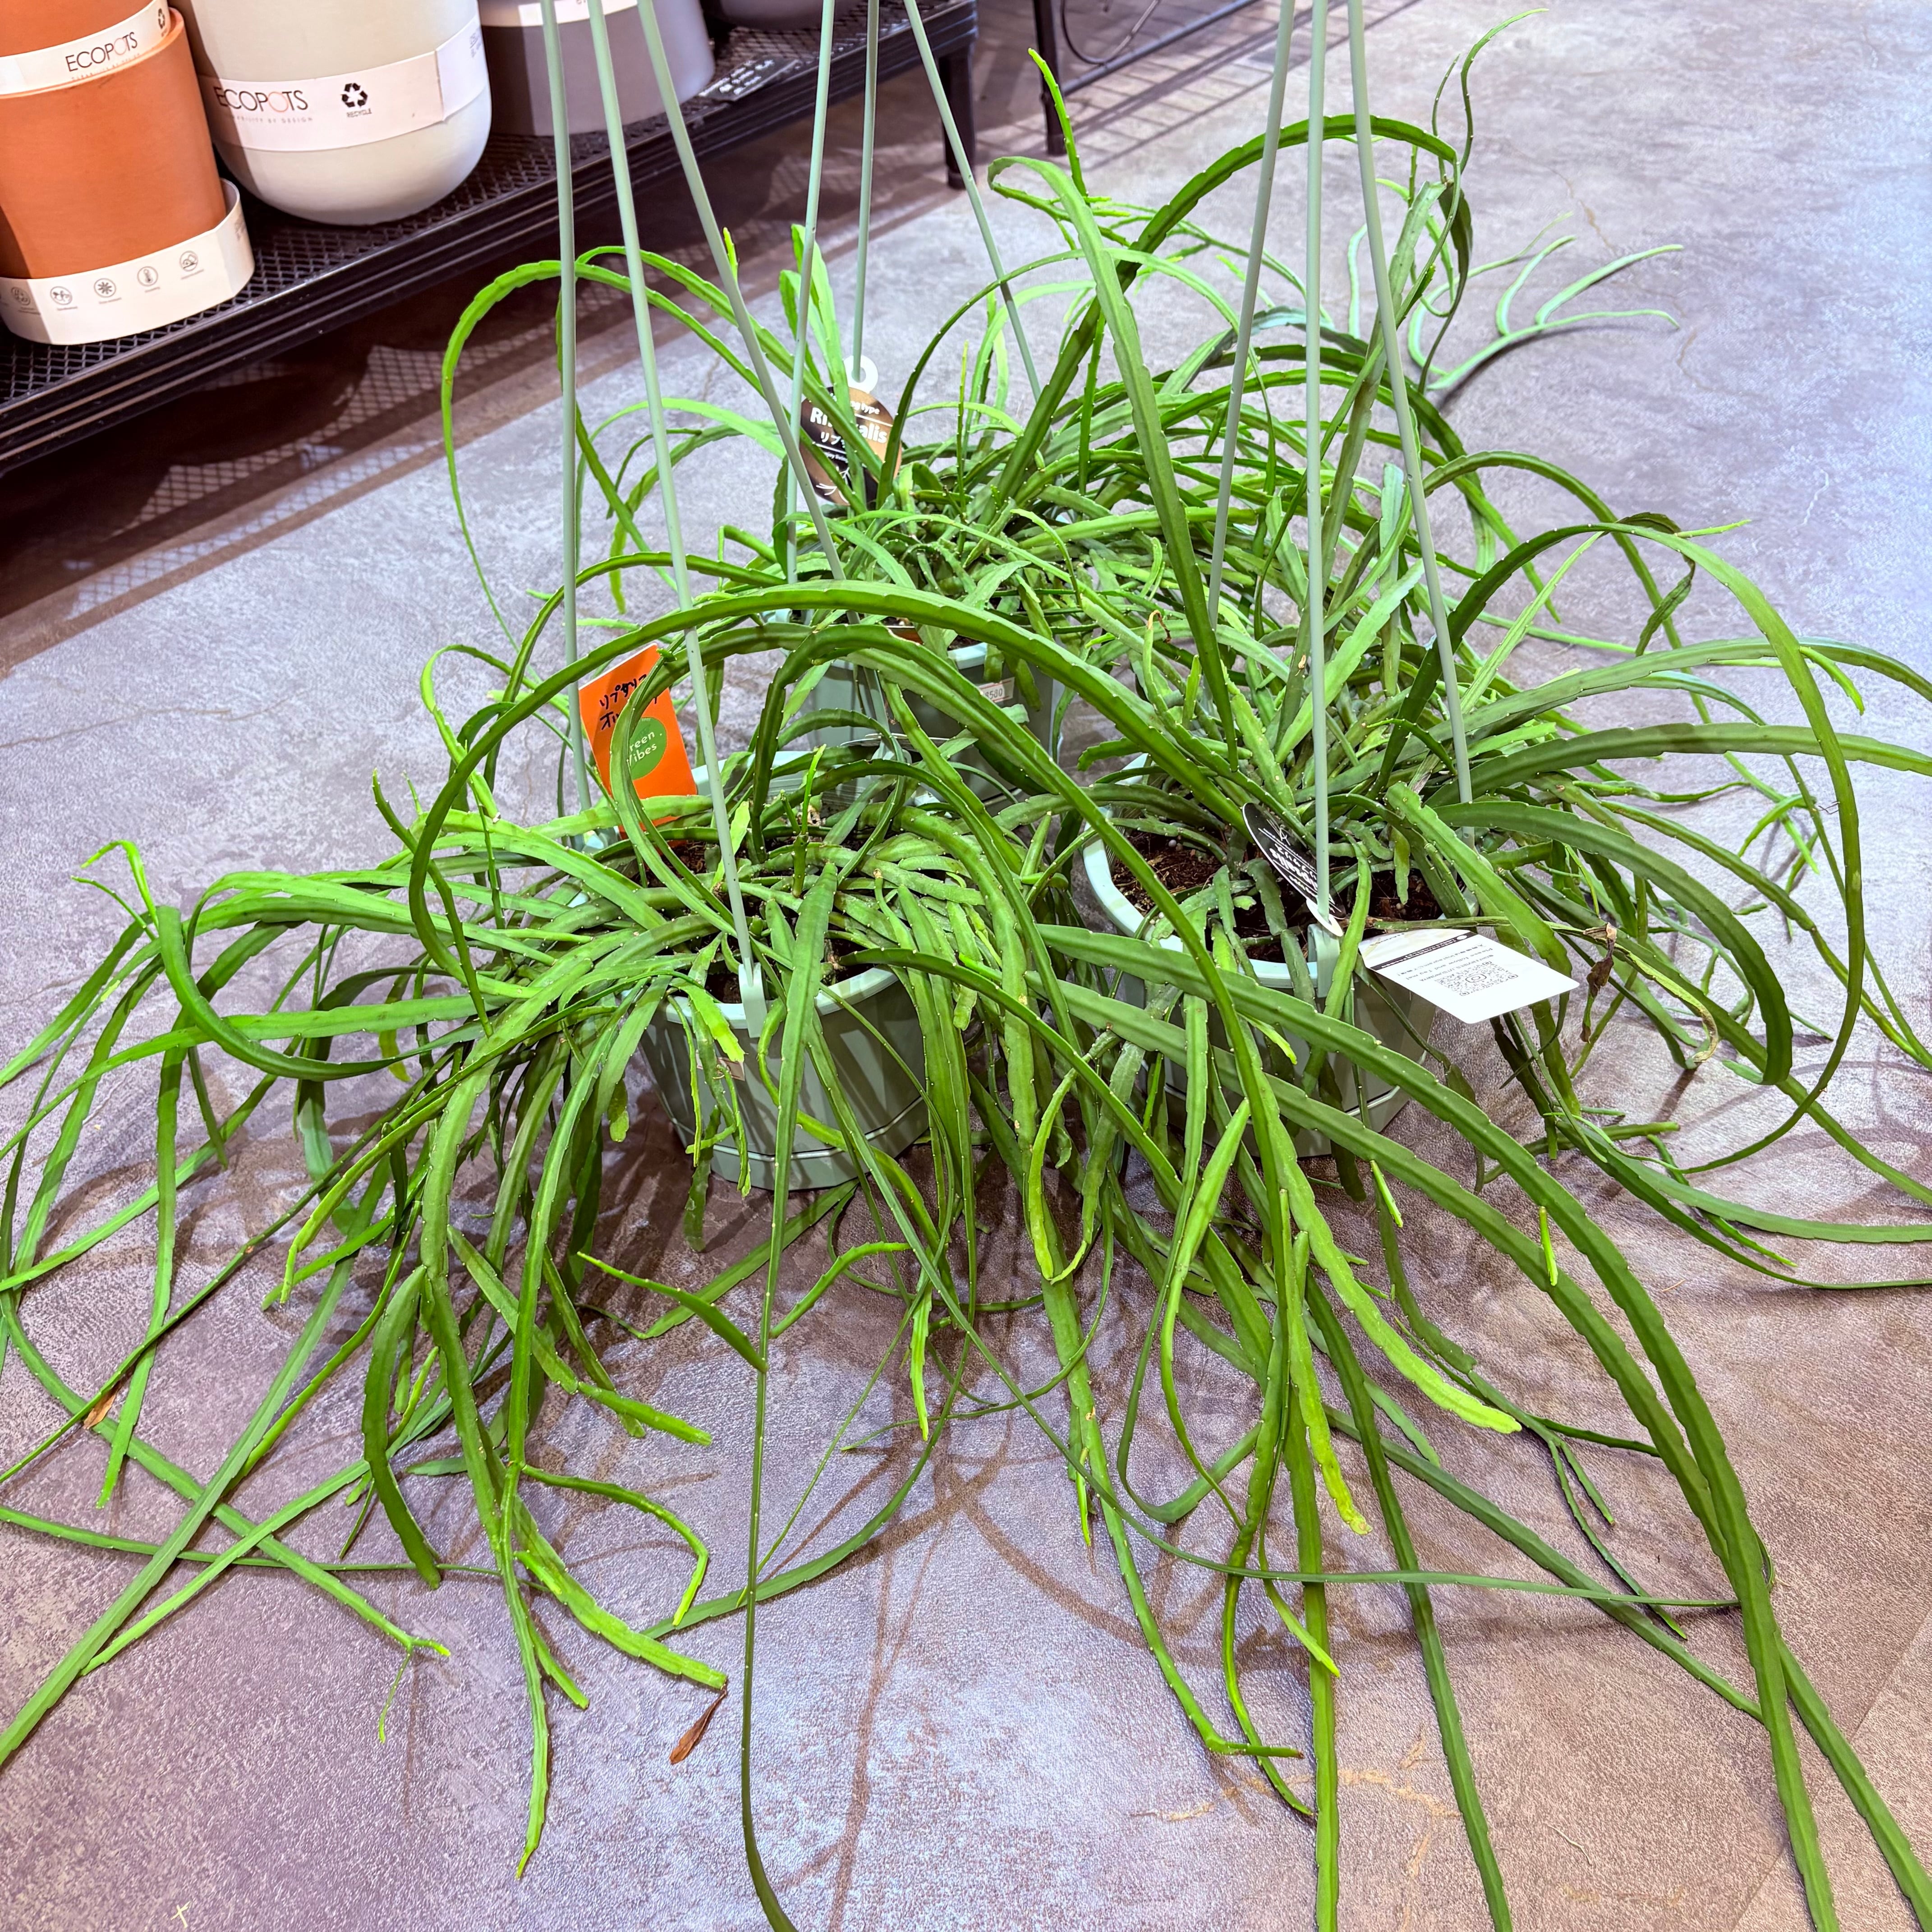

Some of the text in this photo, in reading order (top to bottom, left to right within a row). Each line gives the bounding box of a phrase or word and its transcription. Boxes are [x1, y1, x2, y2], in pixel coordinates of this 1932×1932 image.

[65, 32, 138, 72] ECOPOTS
[213, 86, 308, 113] ECOPOTS
[630, 731, 655, 752] reen
